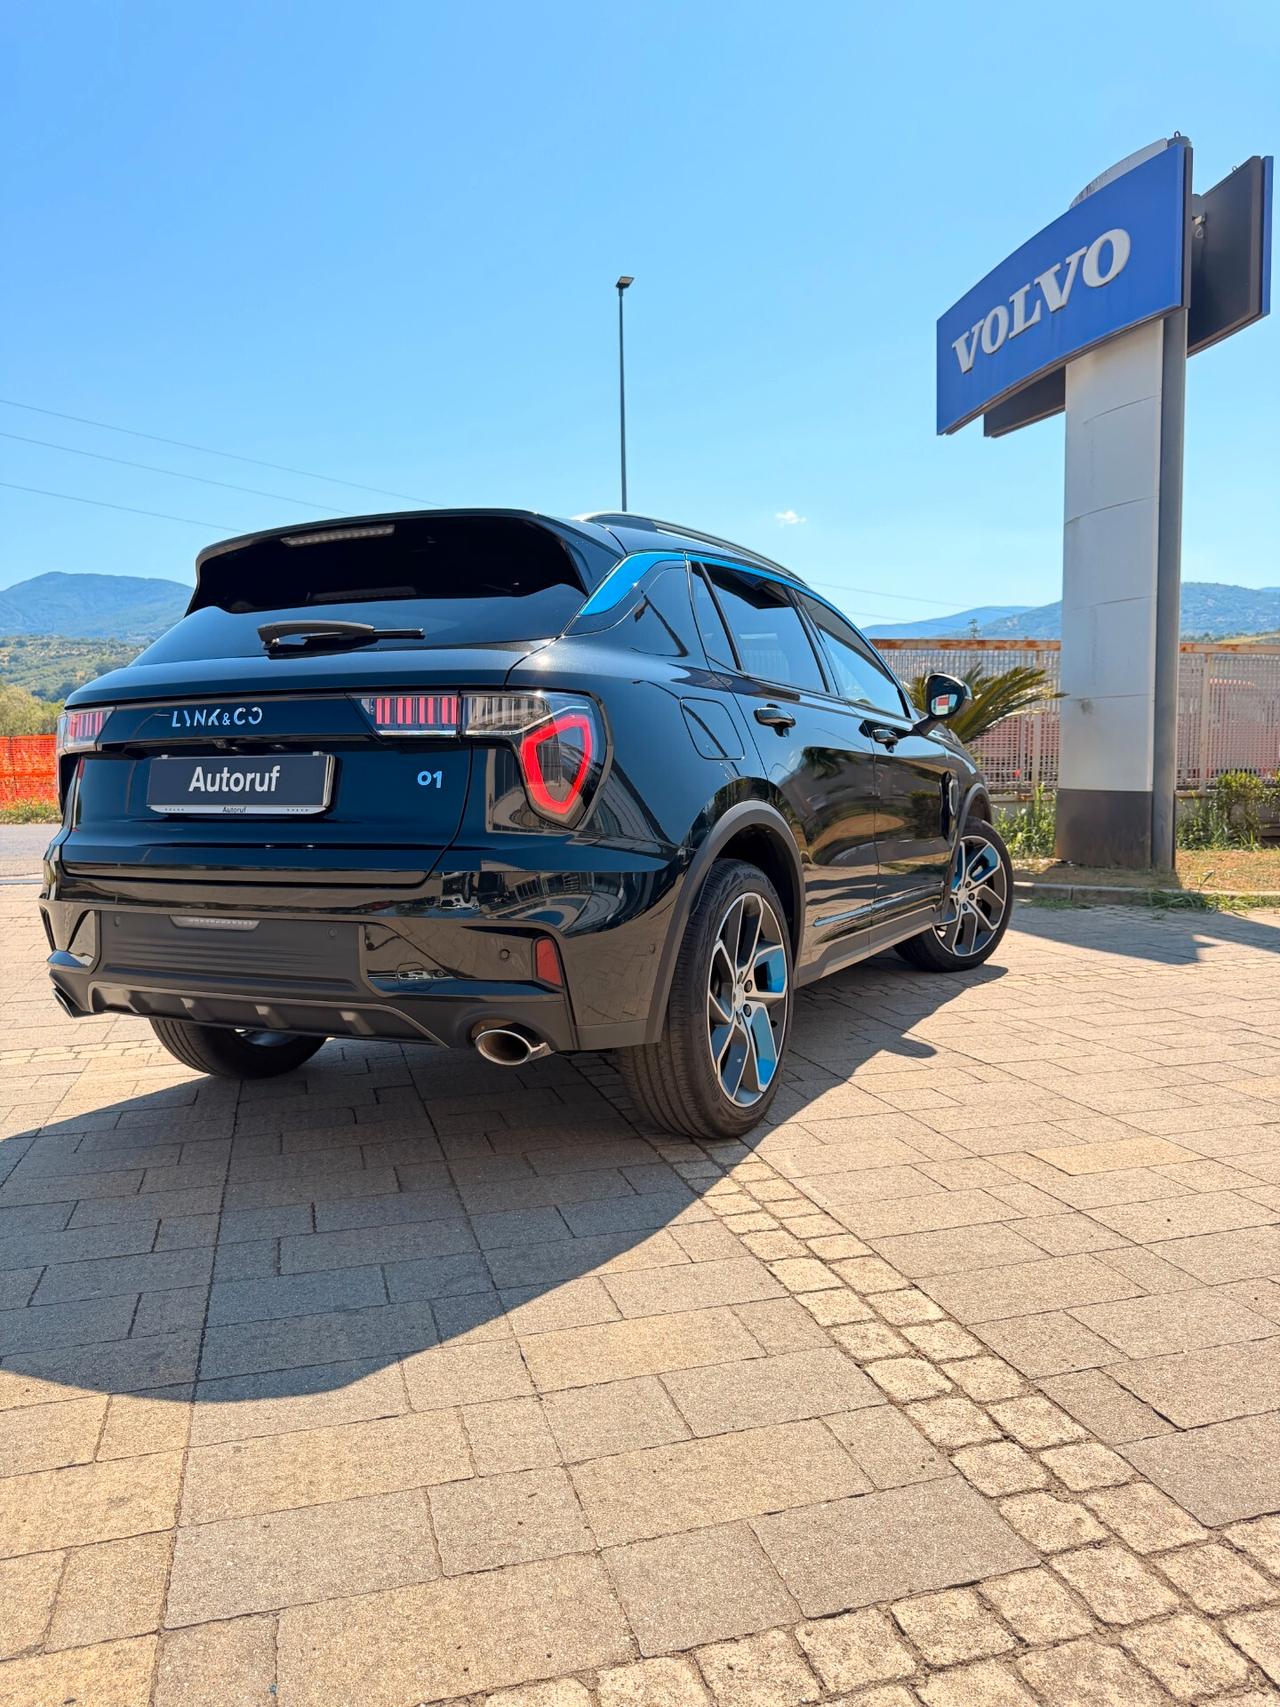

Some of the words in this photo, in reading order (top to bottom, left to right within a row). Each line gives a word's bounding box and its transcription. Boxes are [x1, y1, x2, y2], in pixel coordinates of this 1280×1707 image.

[952, 228, 1131, 374] VOLVO
[188, 765, 281, 792] Autoruf
[417, 770, 443, 789] 01
